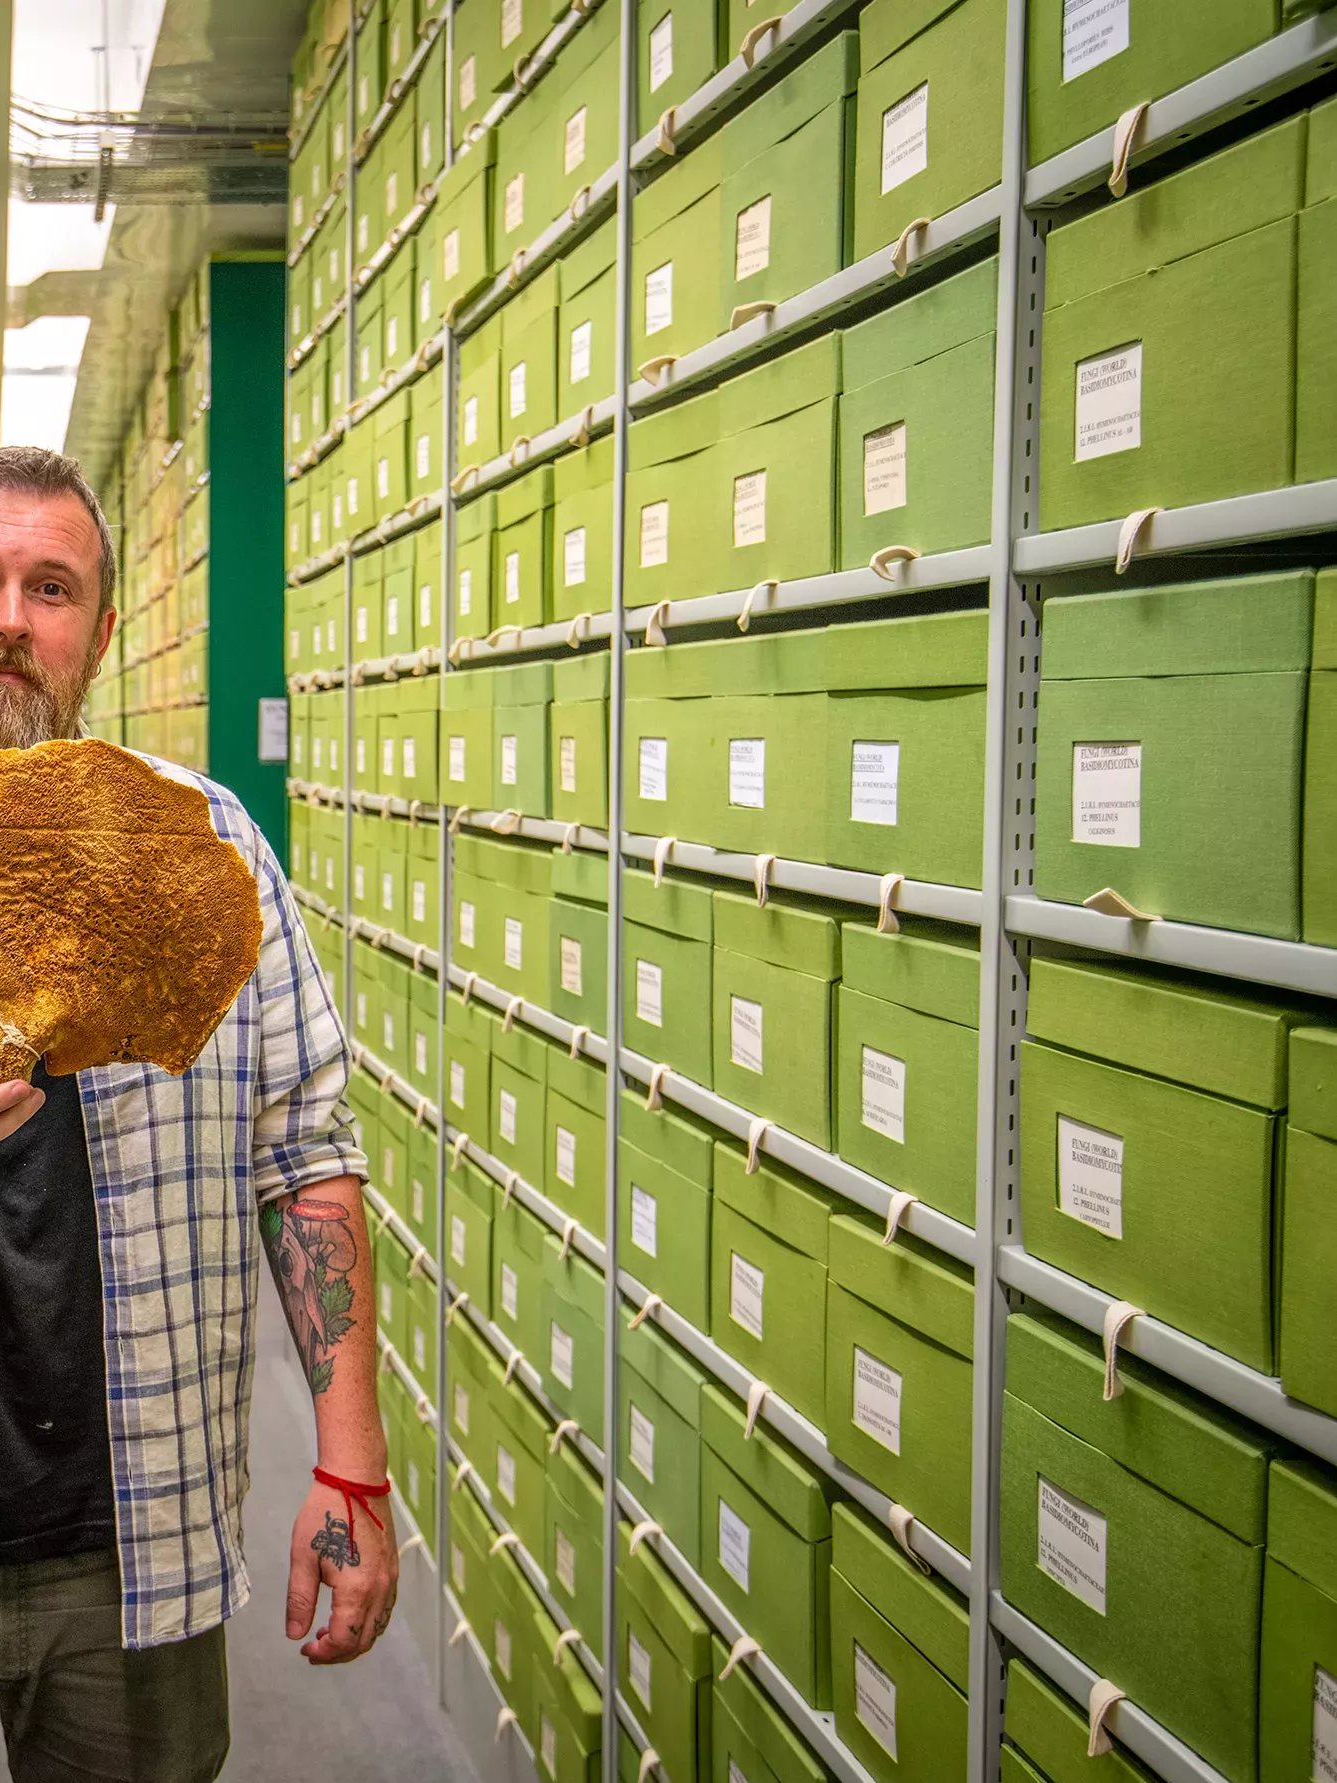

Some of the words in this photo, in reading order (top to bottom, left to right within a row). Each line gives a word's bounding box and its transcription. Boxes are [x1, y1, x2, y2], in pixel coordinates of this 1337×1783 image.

[1080, 367, 1099, 383] FUNGI
[1099, 358, 1127, 375] (WORLD)
[1080, 368, 1138, 396] BASIDIOMYCOTINA
[1087, 429, 1117, 445] PHELLINUS
[1080, 747, 1100, 759] FUNGI
[1080, 759, 1139, 772] BASIDIOMYCOTINA
[1089, 813, 1119, 822] PHELLINUS
[1072, 1138, 1090, 1152] FUNGI
[1091, 1142, 1118, 1160] (WORLD)
[1080, 1199, 1111, 1216] PHELLINUS
[1042, 1486, 1061, 1509] FUNGI
[1061, 1503, 1090, 1532] (WORLD)
[1041, 1499, 1100, 1553] BASIDIOMYCOTINA
[1047, 1553, 1078, 1585] PHELLINUS
